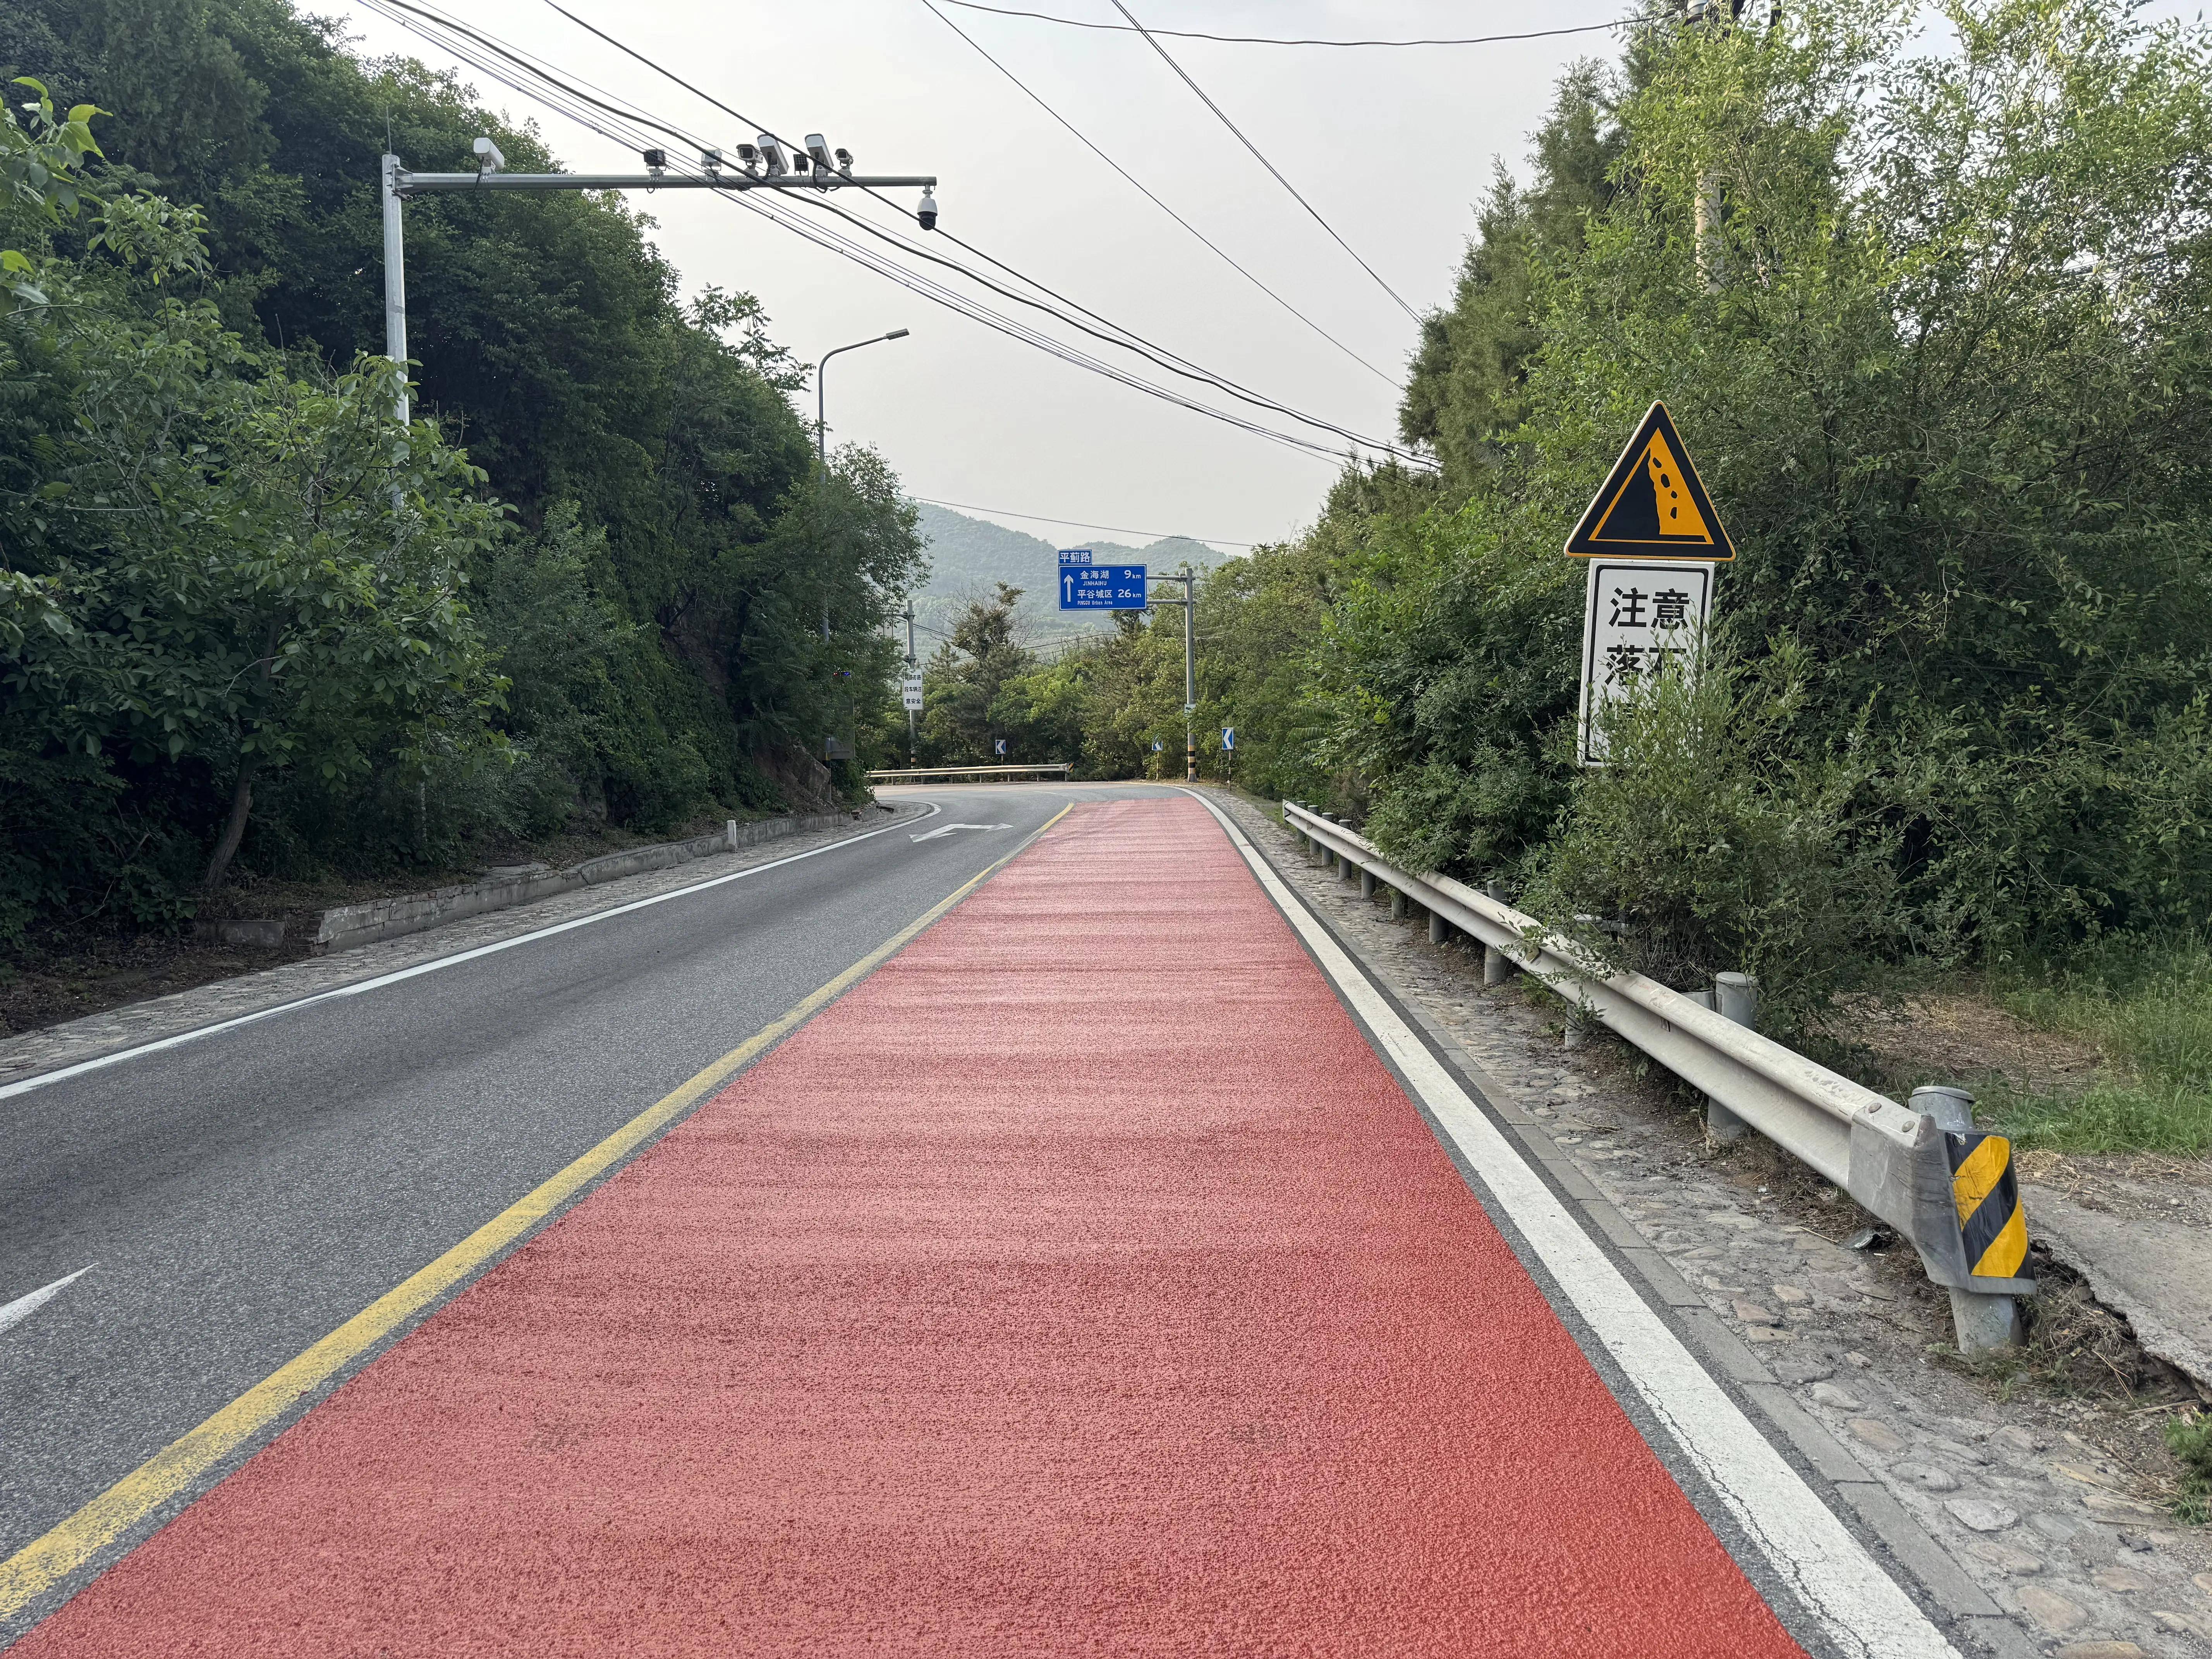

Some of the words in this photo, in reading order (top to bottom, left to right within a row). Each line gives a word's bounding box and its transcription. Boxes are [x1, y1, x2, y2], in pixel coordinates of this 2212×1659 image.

[1060, 552, 1091, 563] 平蓟路
[1080, 570, 1109, 579] 金海湖
[1077, 589, 1113, 599] 平谷城区
[1608, 587, 1690, 630] 注意
